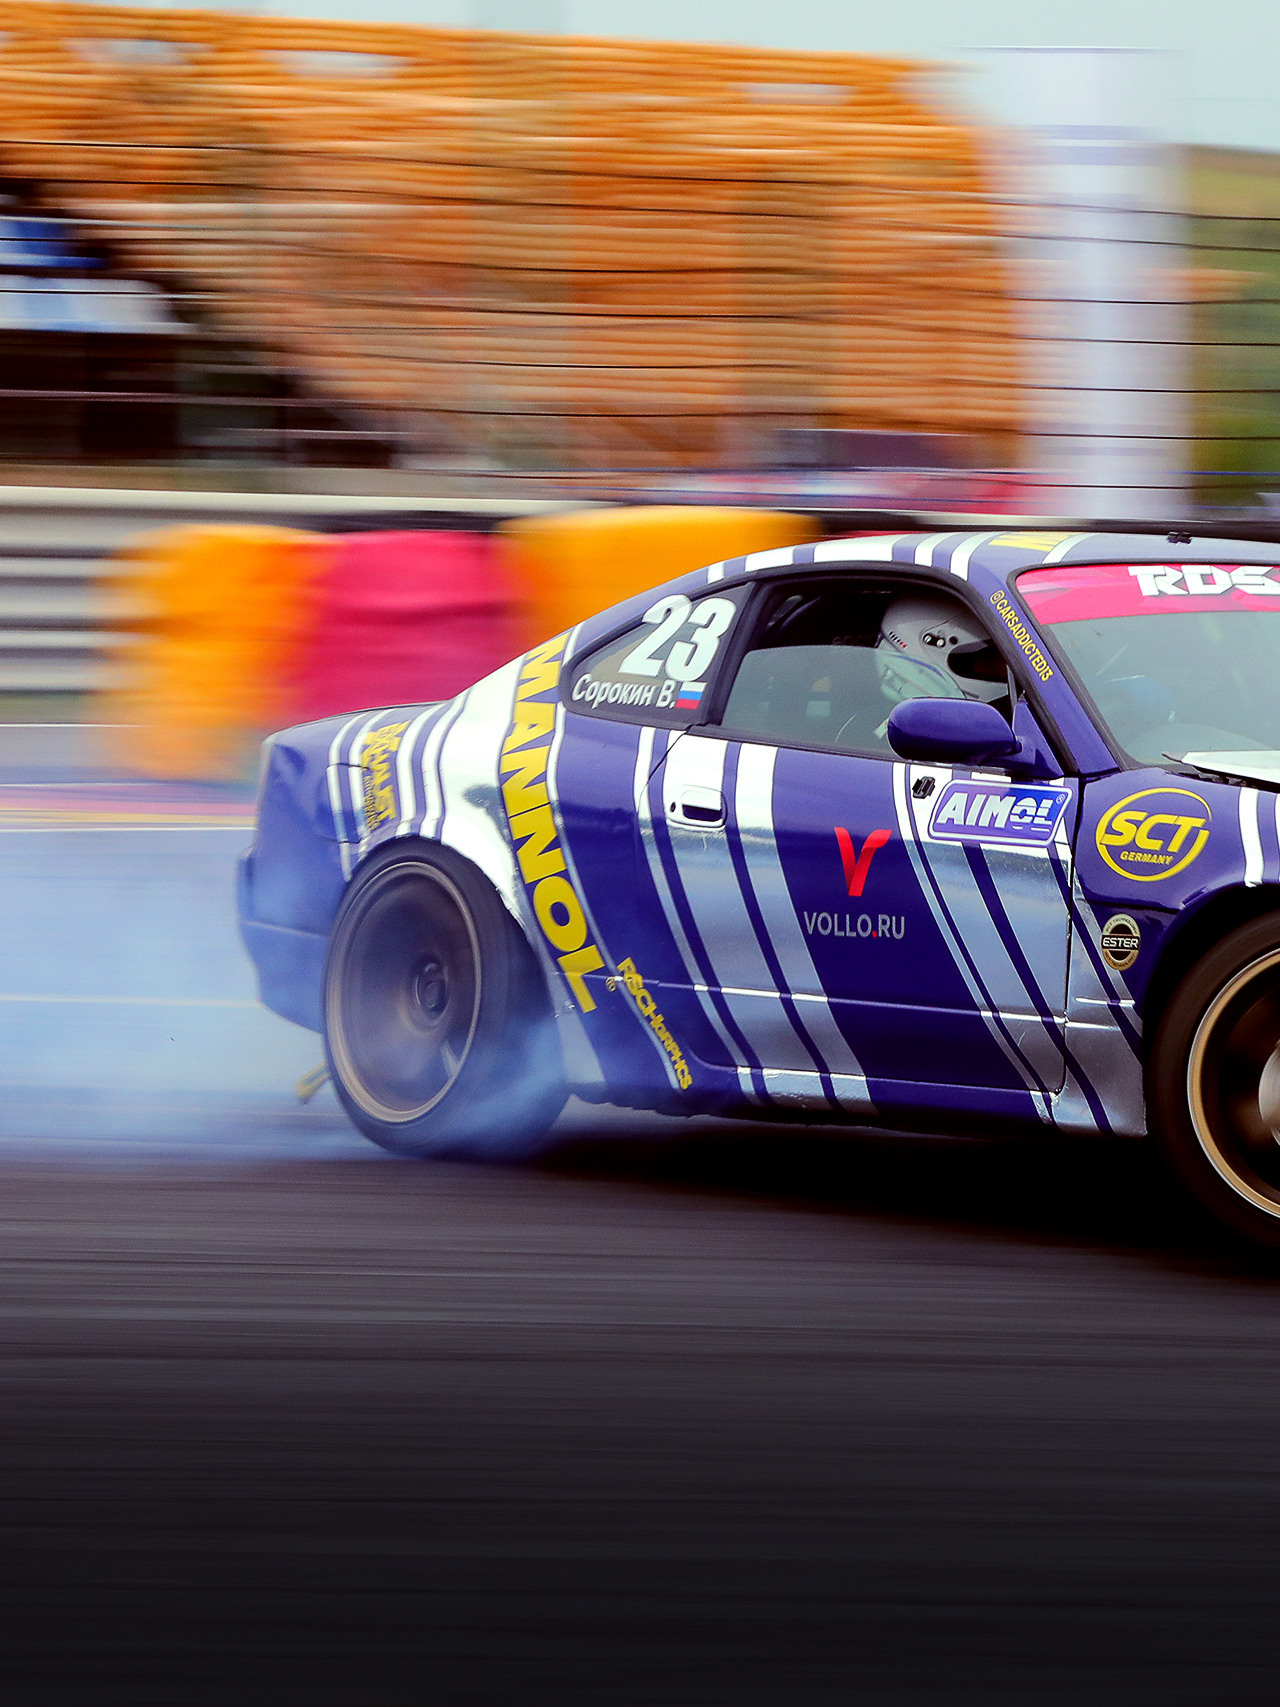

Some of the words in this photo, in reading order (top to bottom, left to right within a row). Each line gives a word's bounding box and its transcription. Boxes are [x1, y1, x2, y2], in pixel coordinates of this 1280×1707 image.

[617, 594, 737, 682] 23
[572, 673, 656, 709] Сорокин
[655, 679, 677, 708] В.
[500, 630, 606, 1014] MANNOL
[937, 792, 1054, 832] AIMOL
[1099, 810, 1206, 852] SCT
[1120, 850, 1173, 865] GERMANY
[803, 911, 905, 939] VOLLO.RU
[1102, 937, 1139, 948] ESTER
